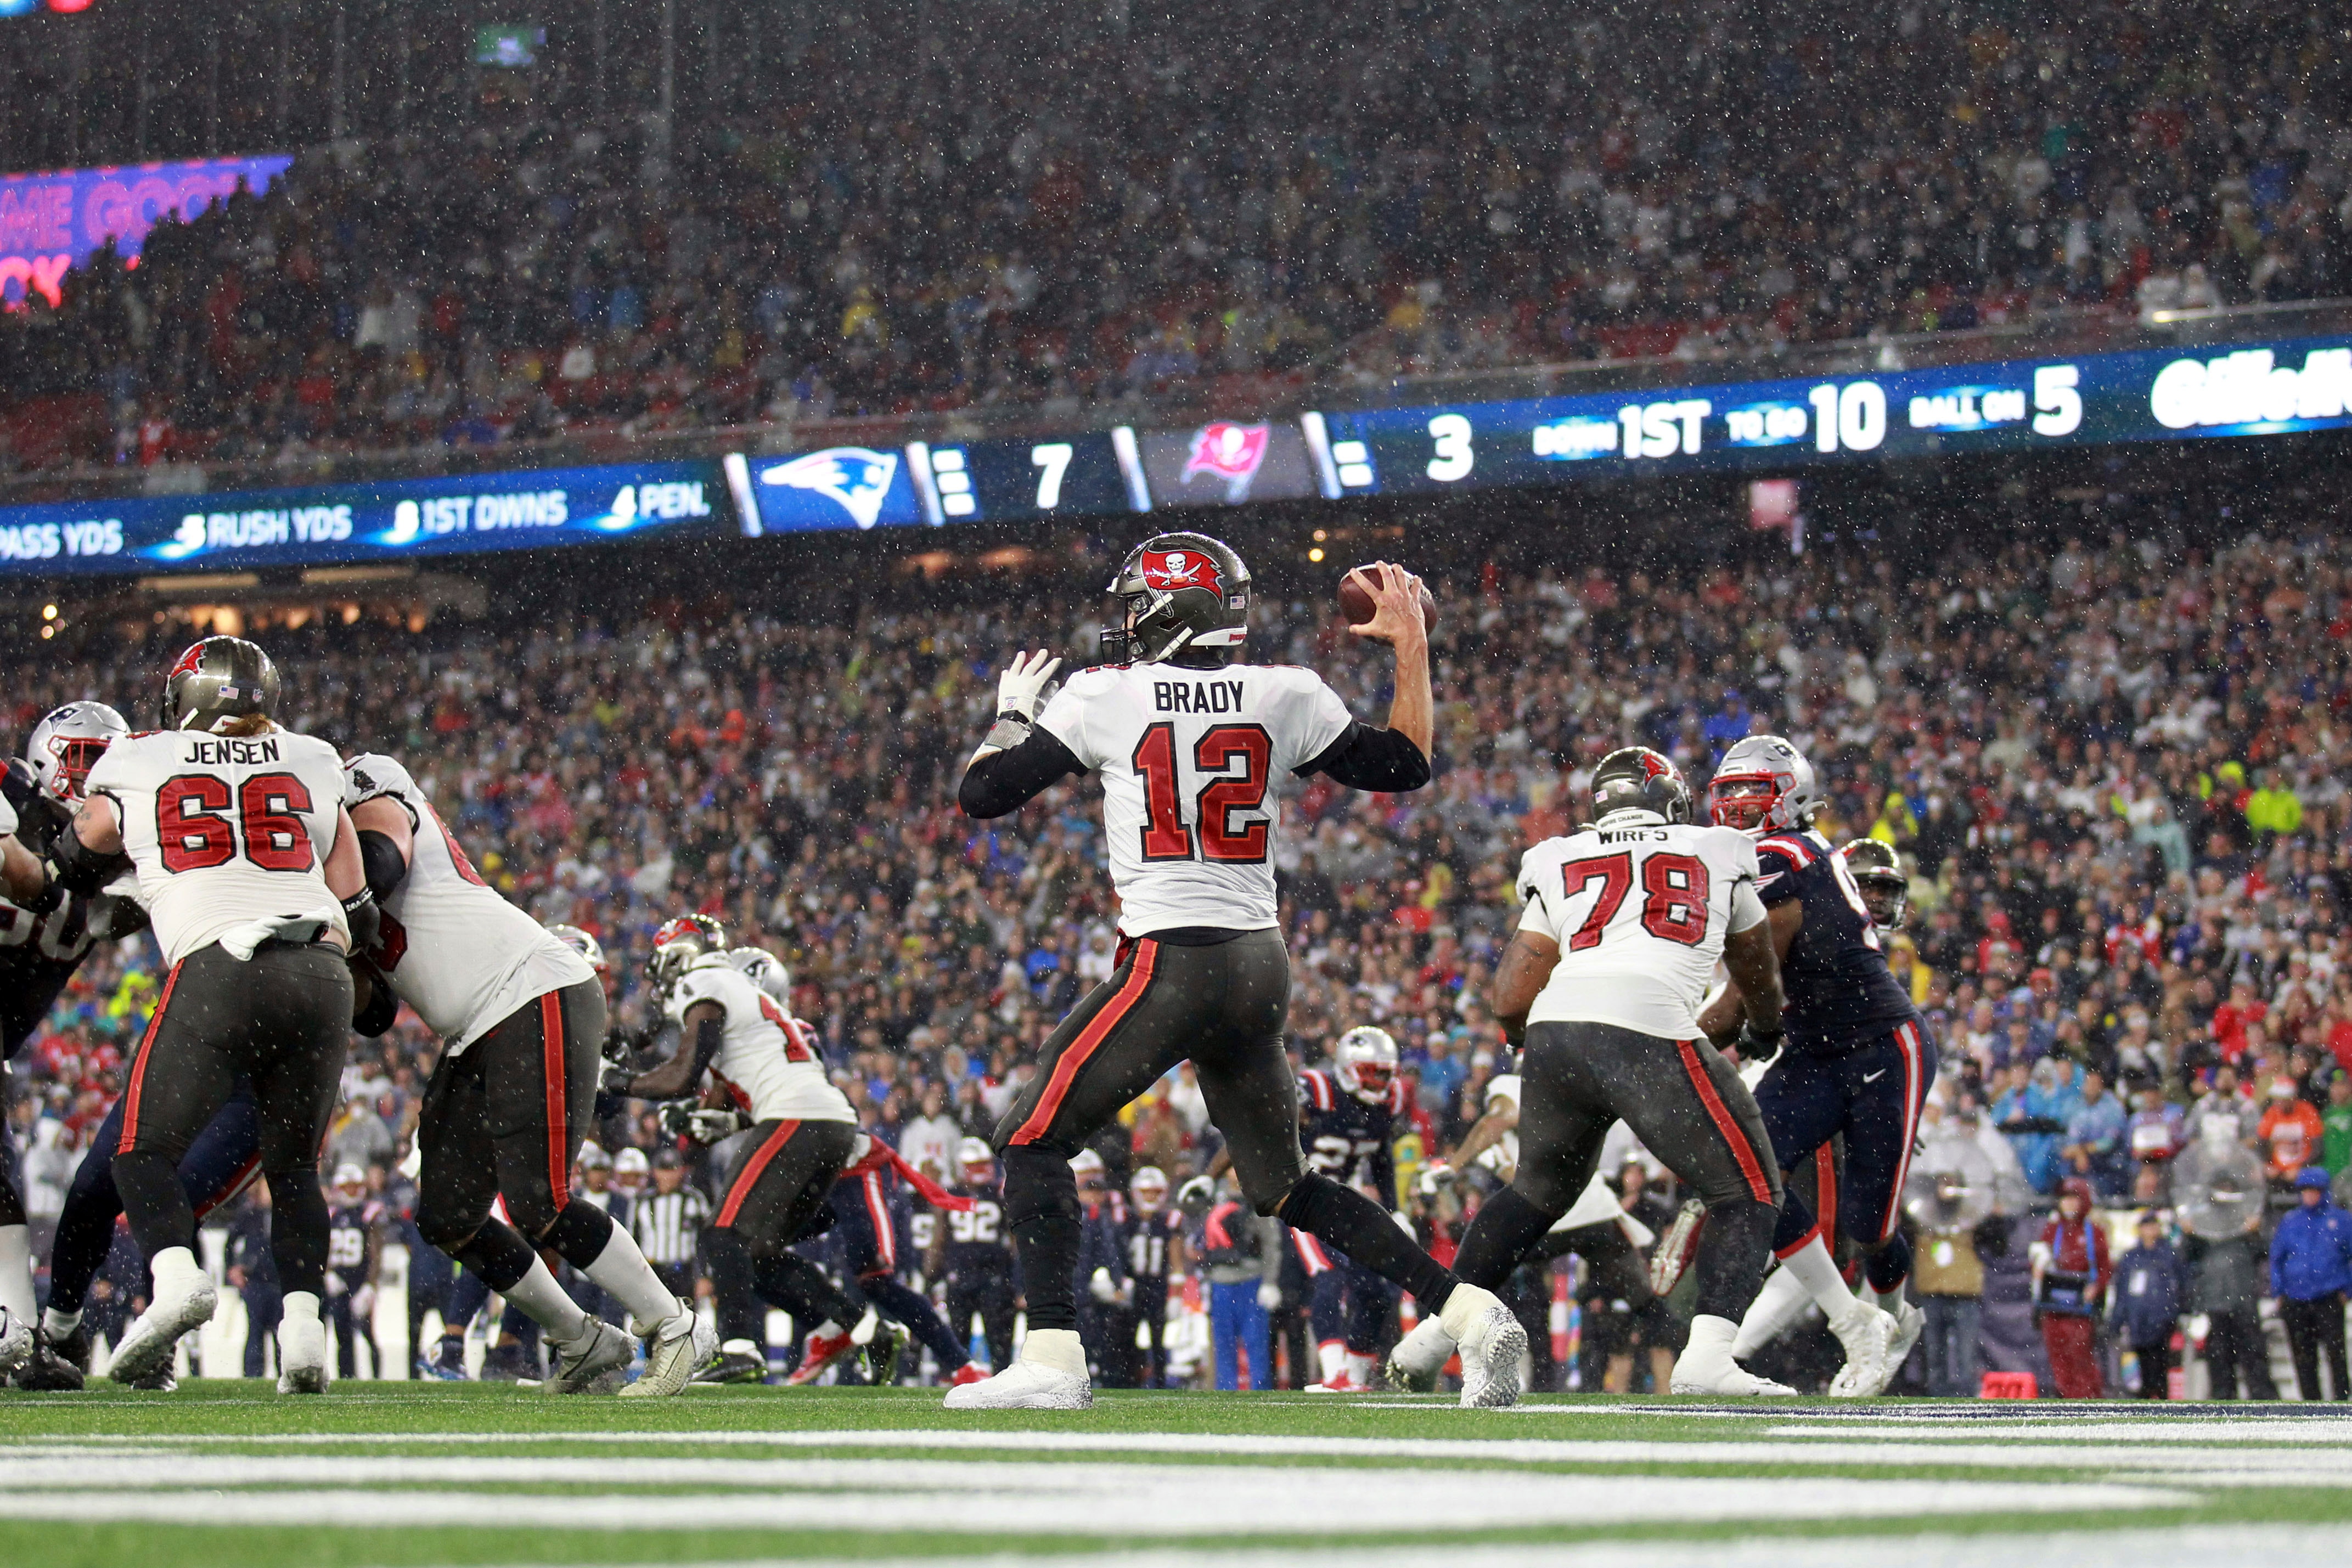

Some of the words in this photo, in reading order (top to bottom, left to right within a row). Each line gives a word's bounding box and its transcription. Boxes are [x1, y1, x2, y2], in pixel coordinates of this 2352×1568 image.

[1809, 380, 1886, 453] 10
[2033, 364, 2083, 436] 5
[2151, 347, 2352, 429] Gillett
[1427, 413, 1475, 481] 3
[1618, 398, 1712, 459] 1ST
[639, 481, 711, 518] PEN.
[1032, 443, 1073, 509] 7
[61, 518, 123, 556] YDS
[207, 509, 289, 549] RUSH
[291, 504, 352, 543] YDS
[422, 495, 472, 533] 1ST
[475, 489, 569, 531] DWNS
[1154, 680, 1243, 713] BRADY
[184, 738, 279, 765] JENSEN
[156, 772, 315, 875] 66
[1132, 721, 1273, 865] 12
[1561, 850, 1710, 953] 78
[948, 1200, 1001, 1243] 92
